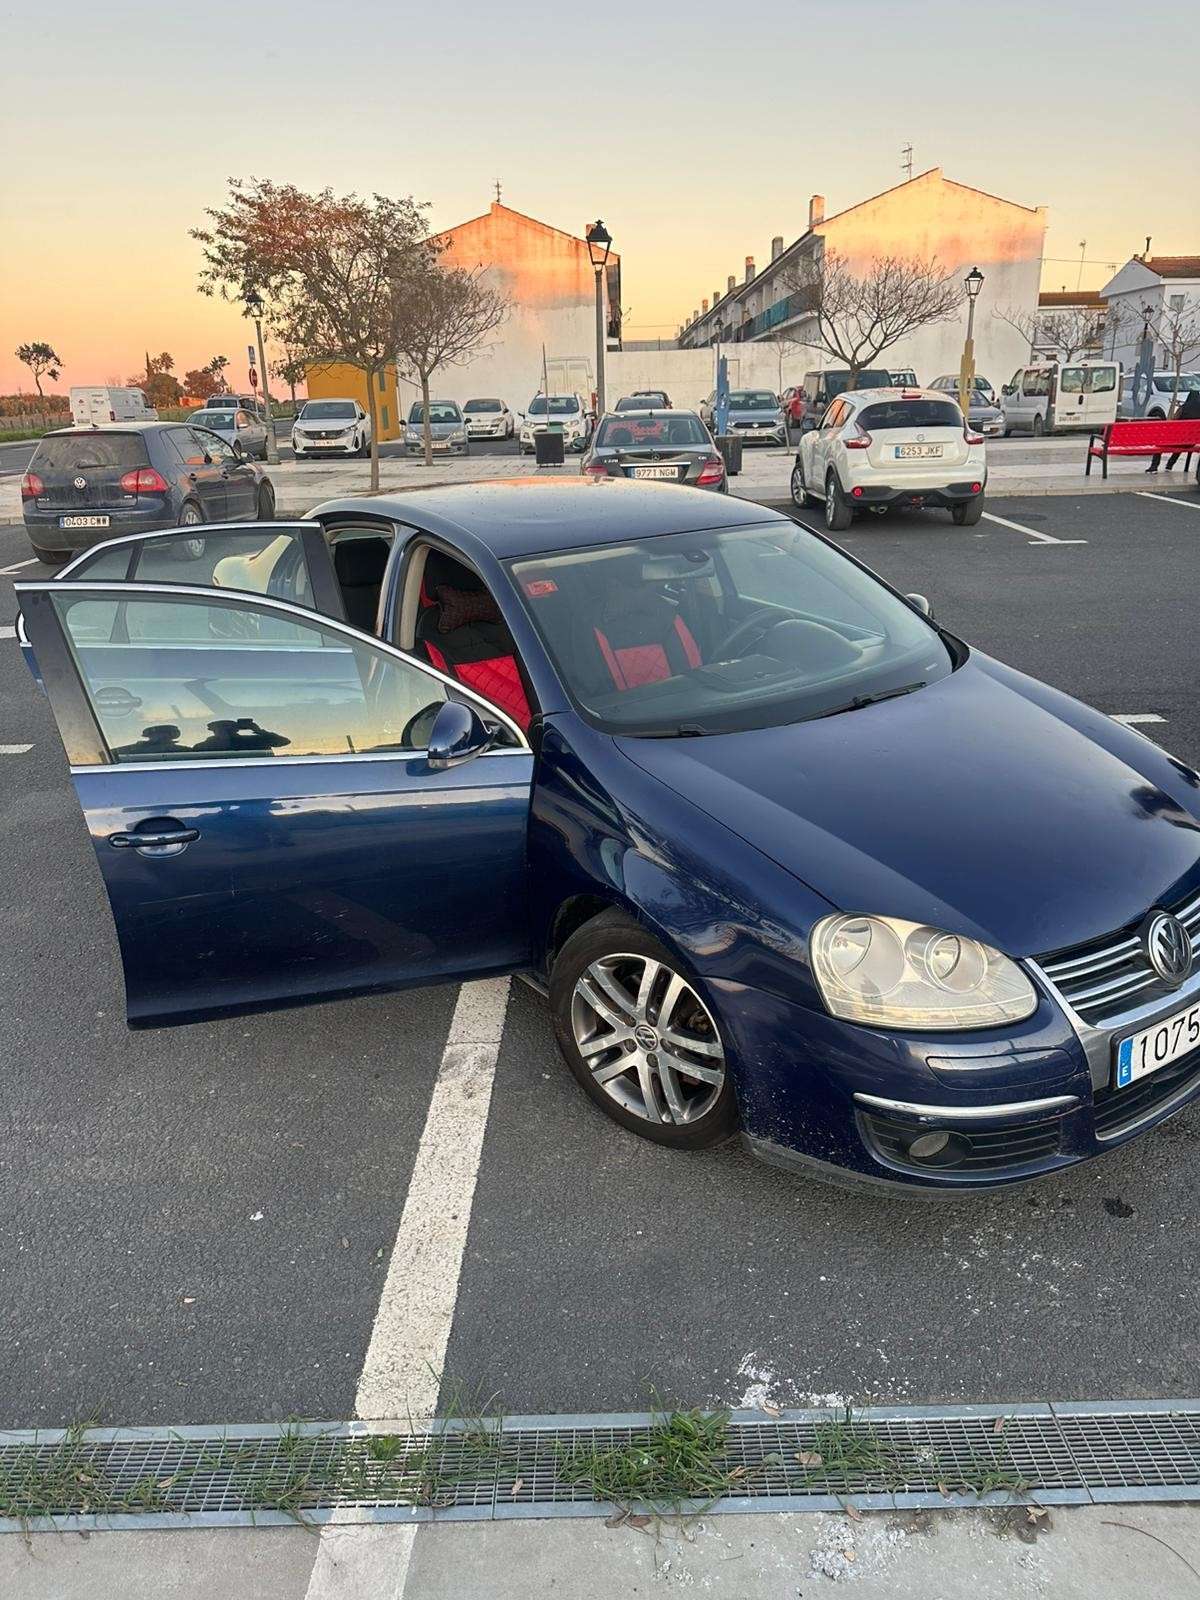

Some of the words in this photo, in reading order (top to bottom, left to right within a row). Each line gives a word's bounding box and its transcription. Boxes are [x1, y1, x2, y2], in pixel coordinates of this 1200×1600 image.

[900, 446, 922, 456] 6253
[925, 445, 941, 455] JKF
[635, 468, 657, 478] 9771
[1140, 1008, 1200, 1069] 1075
